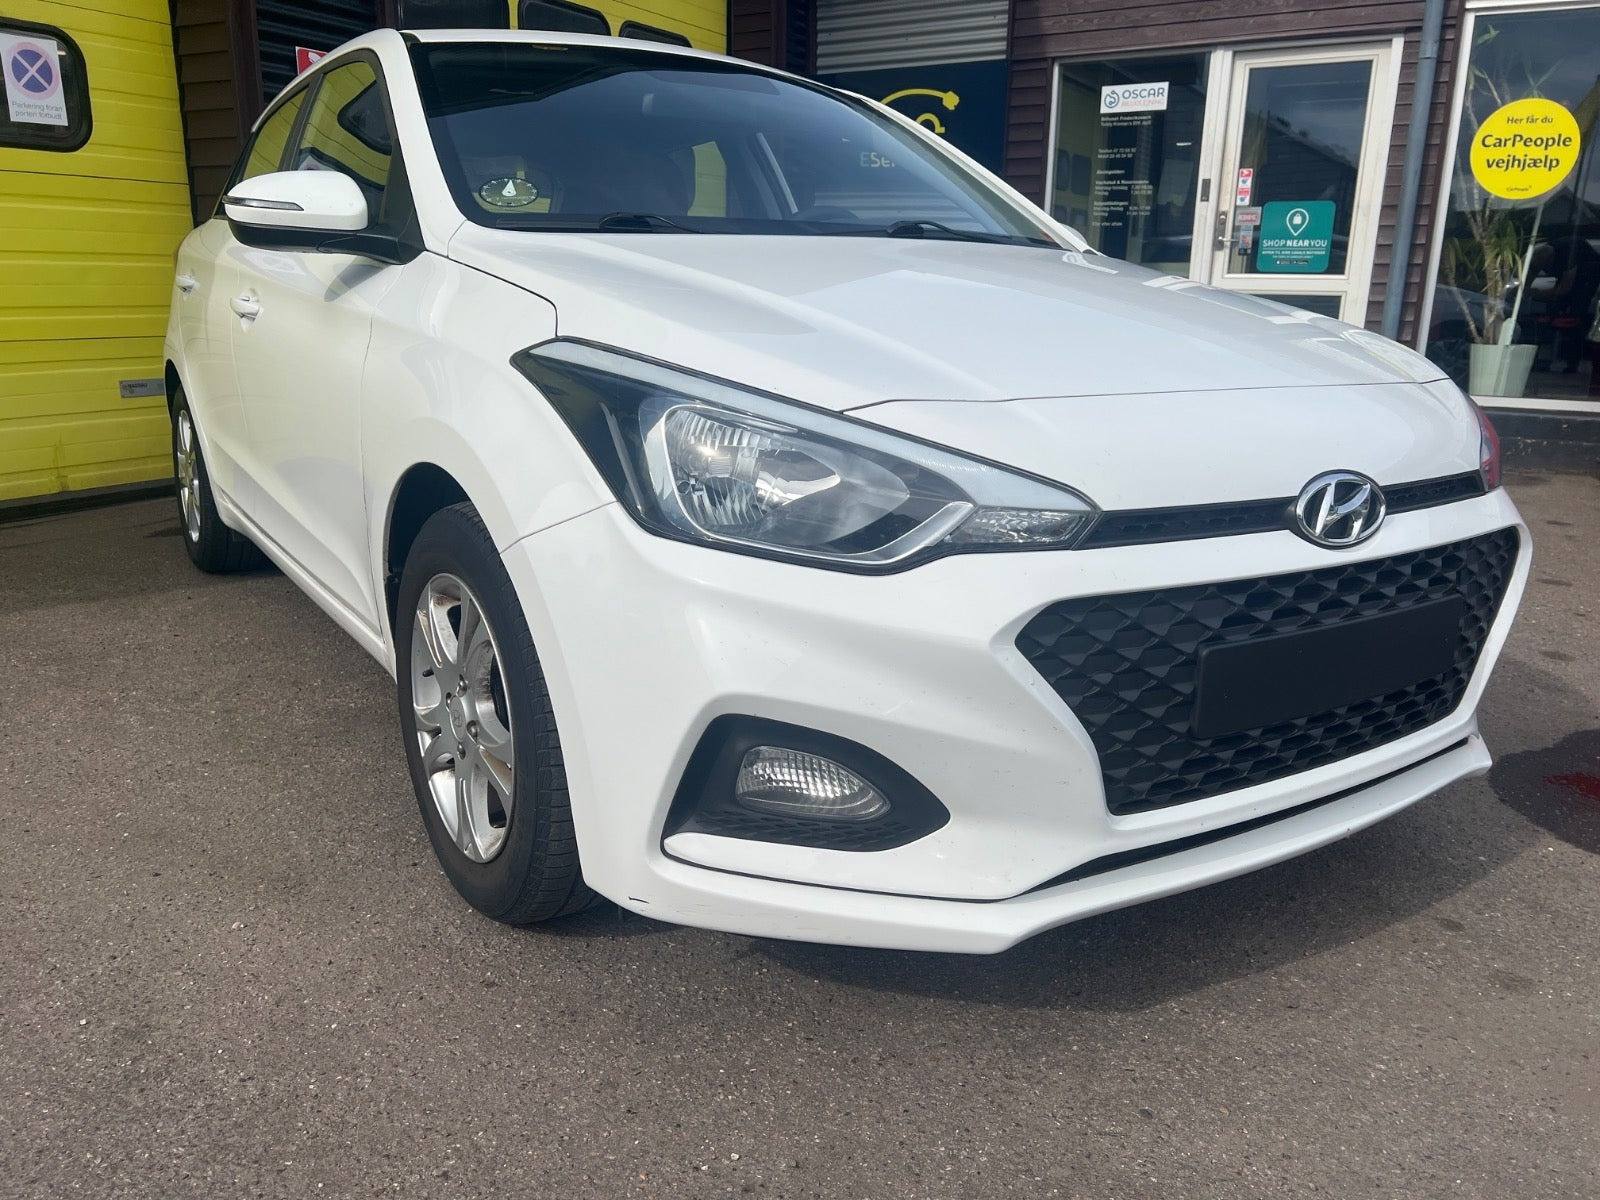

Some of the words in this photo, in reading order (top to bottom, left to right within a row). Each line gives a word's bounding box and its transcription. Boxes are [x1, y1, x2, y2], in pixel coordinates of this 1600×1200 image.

[1122, 87, 1165, 100] OSCAR
[1506, 116, 1524, 125] Her
[1525, 115, 1538, 124] får
[1540, 115, 1554, 124] du
[1481, 133, 1573, 151] CarPeople
[1486, 154, 1560, 172] vejhjælp
[1263, 239, 1286, 248] SHOP
[1286, 239, 1309, 247] NEAR
[1310, 239, 1328, 247] YOU
